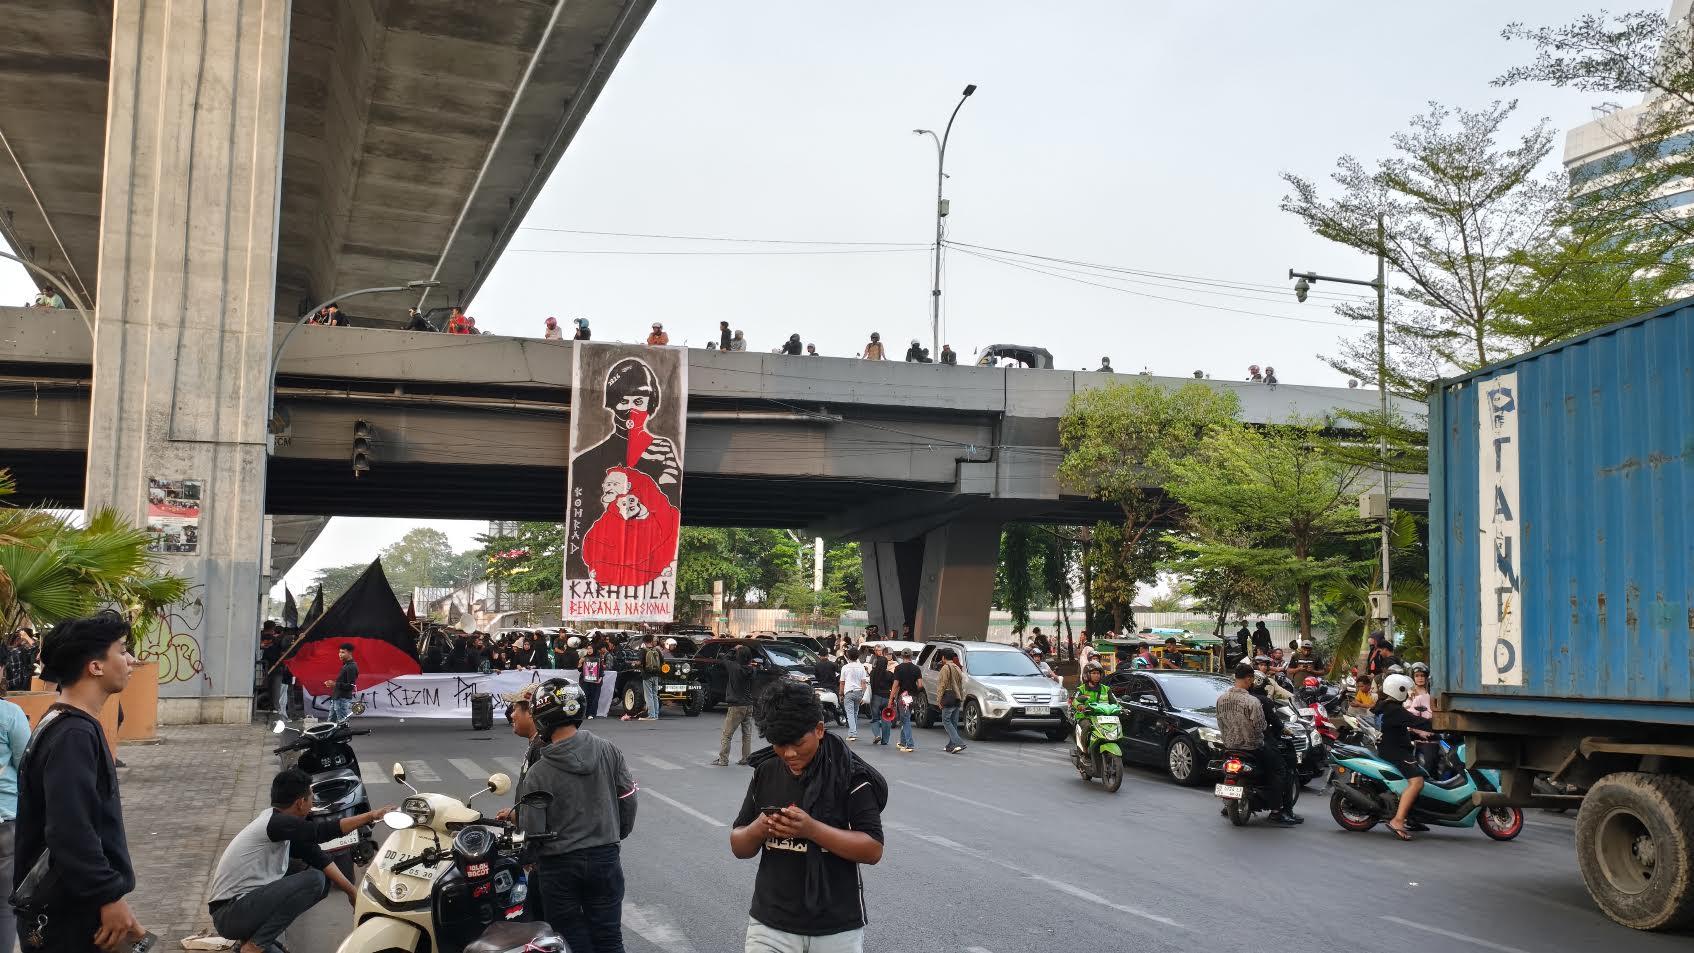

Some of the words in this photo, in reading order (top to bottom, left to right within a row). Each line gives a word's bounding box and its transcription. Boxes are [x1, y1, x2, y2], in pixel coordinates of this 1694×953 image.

[570, 487, 583, 554] KOMRAD
[569, 601, 621, 615] BENCANA
[624, 602, 671, 615] NASIONAL
[386, 681, 440, 707] REZIM
[385, 850, 397, 860] DD
